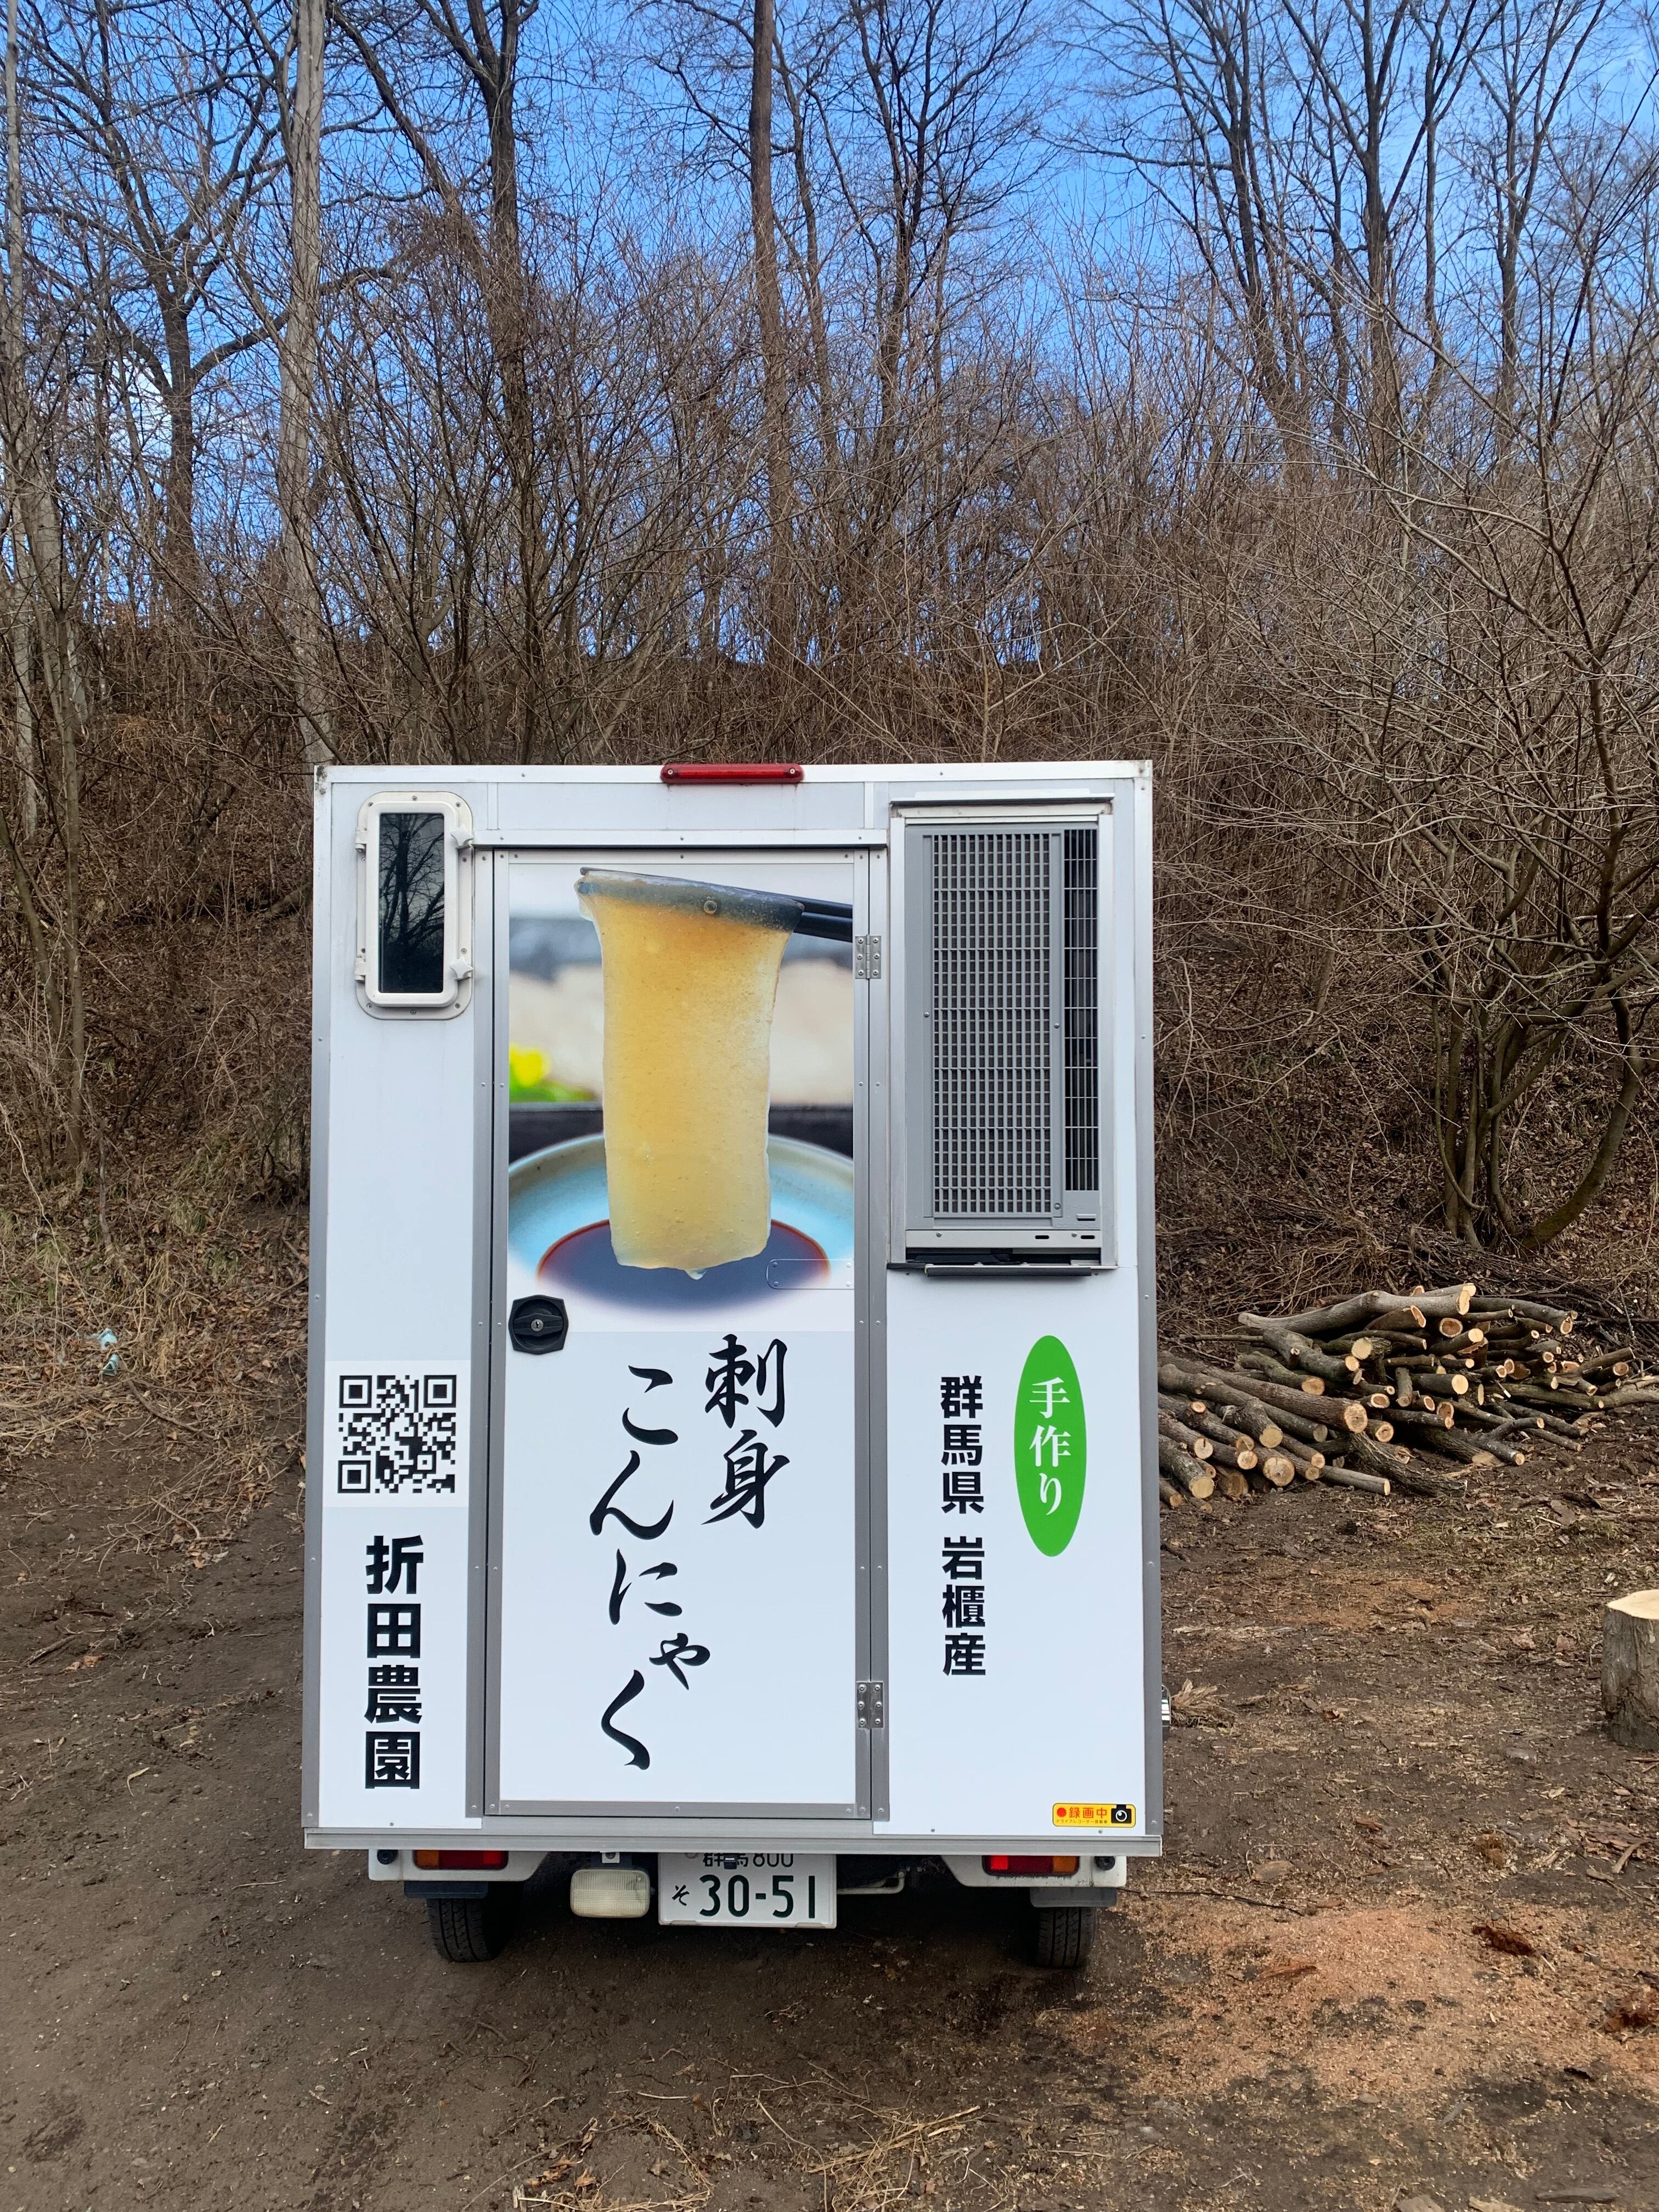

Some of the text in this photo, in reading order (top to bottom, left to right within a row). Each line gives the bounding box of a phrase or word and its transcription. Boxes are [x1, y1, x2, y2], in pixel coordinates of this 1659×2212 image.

[702, 1334, 790, 1529] 刺身
[940, 1375, 986, 1677] 群馬県 岩櫃産
[1029, 1376, 1071, 1516] 手作り
[364, 1534, 425, 1790] 折田農園
[589, 1365, 711, 1770] こんにゃく
[672, 1874, 816, 1919] そ 30-51
[1069, 1807, 1107, 1819] 録画中
